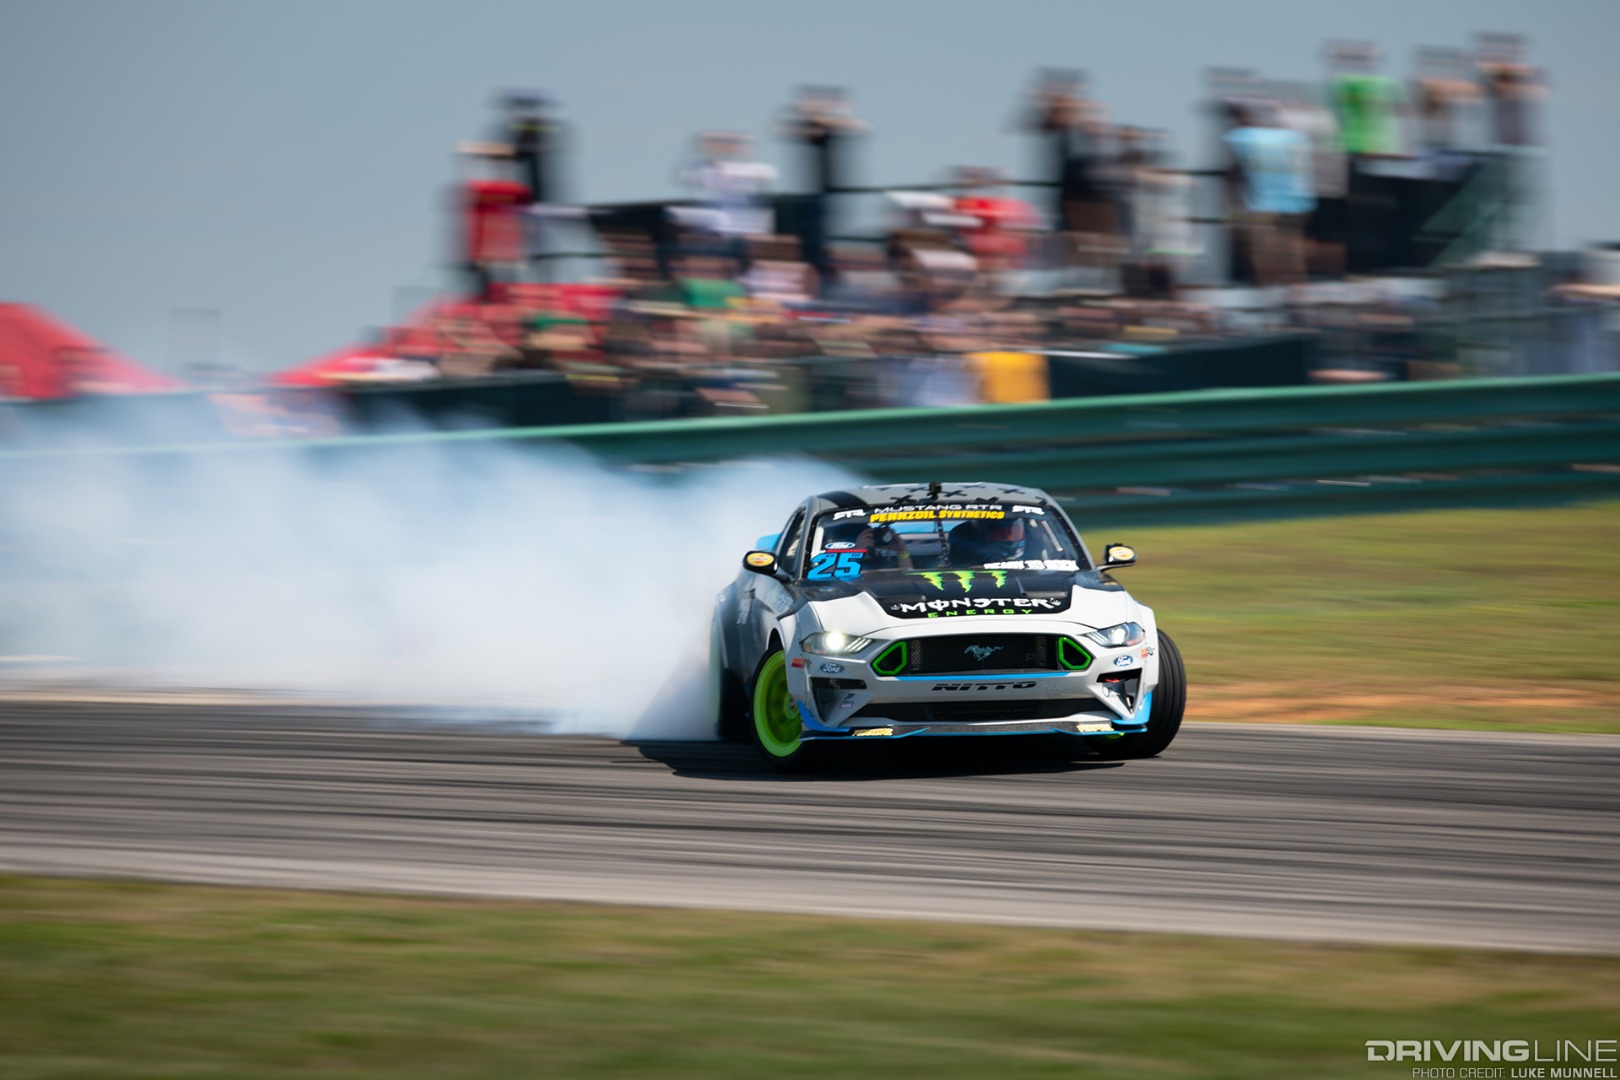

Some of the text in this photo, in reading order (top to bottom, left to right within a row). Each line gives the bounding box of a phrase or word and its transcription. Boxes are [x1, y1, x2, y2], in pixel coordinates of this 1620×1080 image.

[874, 504, 962, 514] MUSTANG
[869, 510, 1005, 523] PENNZOIL SYNTHETICS
[807, 552, 865, 579] 25
[900, 597, 1055, 613] MONSTER
[927, 609, 1033, 618] ENERGY
[821, 662, 843, 673] Ford
[931, 681, 1037, 691] NITTO
